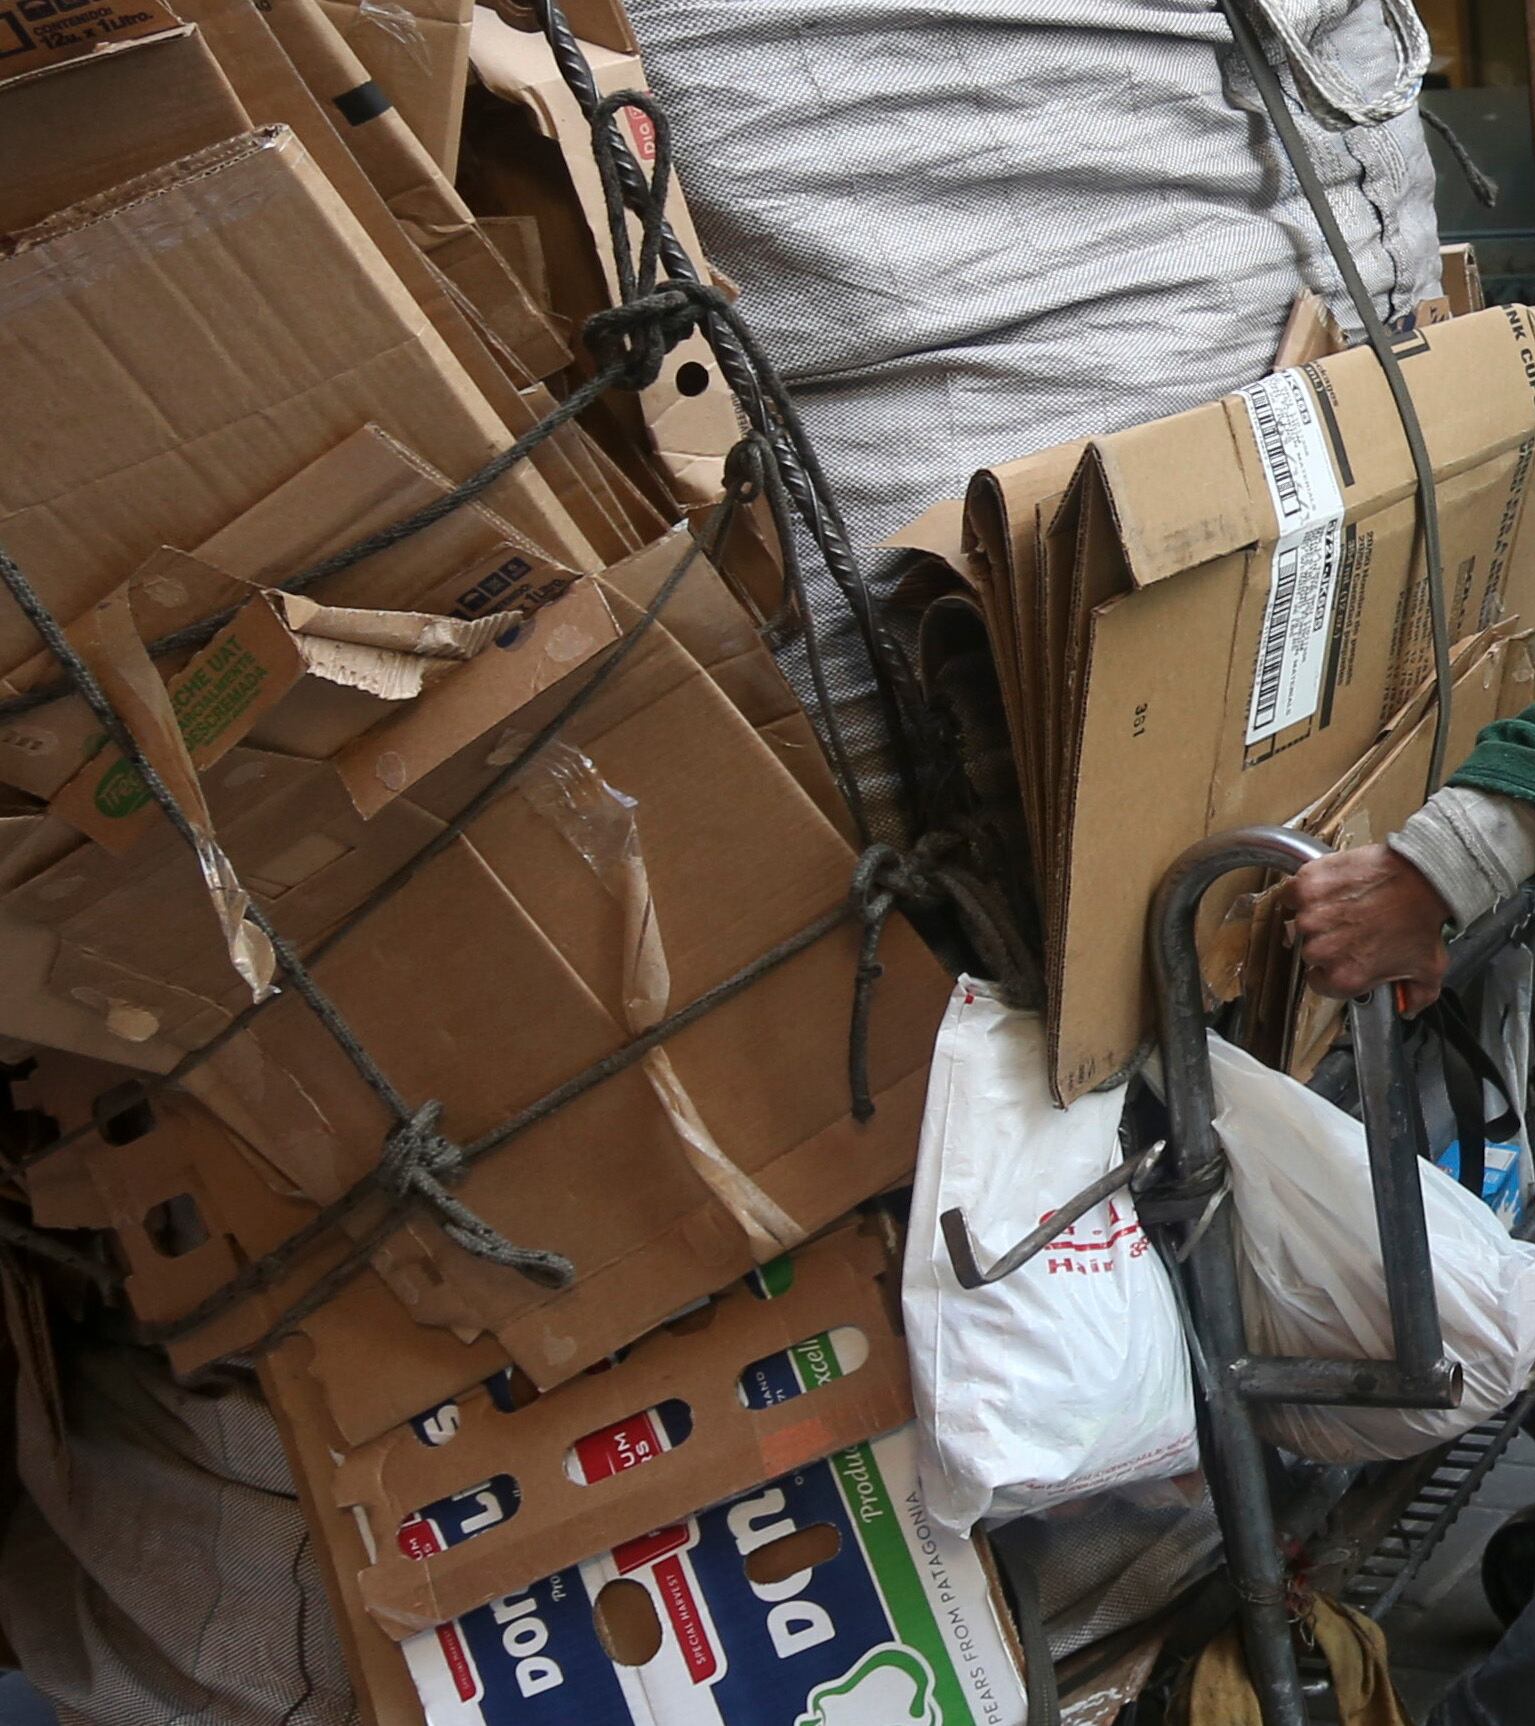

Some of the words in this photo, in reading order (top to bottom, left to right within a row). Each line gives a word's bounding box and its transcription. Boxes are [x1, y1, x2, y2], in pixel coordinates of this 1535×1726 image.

[905, 1490, 956, 1604] PATAGONIA
[666, 1573, 688, 1620] HARVEST
[684, 1621, 707, 1665] SPECIAL
[947, 1606, 978, 1663] FROM
[967, 1665, 1003, 1725] PEARS
